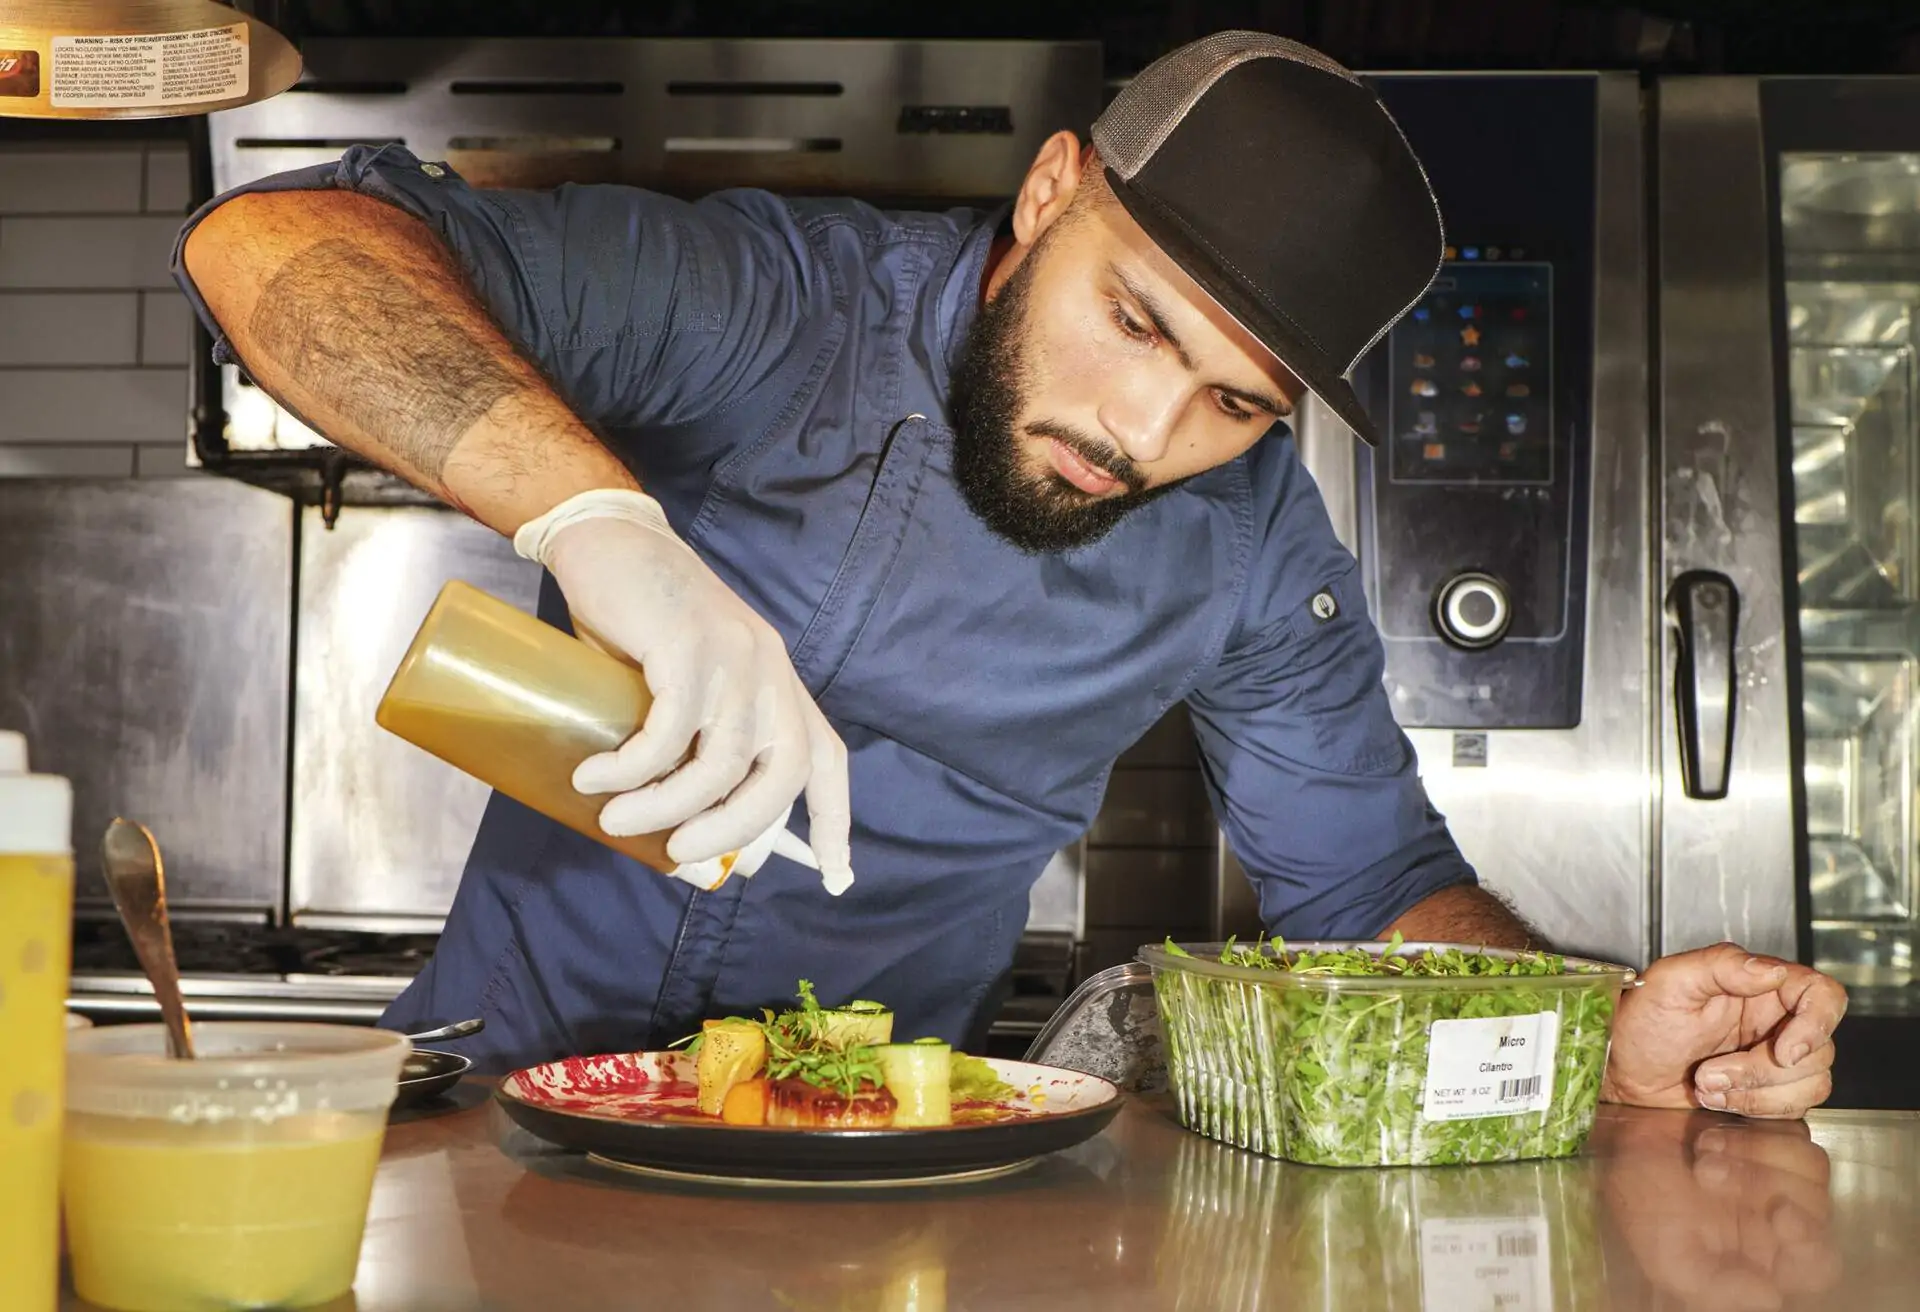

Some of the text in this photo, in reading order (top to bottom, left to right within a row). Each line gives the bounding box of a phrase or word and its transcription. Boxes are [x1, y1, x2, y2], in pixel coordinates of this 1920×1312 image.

[1499, 1036, 1526, 1047] Micro
[1479, 1062, 1513, 1073] Cilantro
[1434, 1088, 1451, 1097] NET
[1478, 1086, 1491, 1095] OZ
